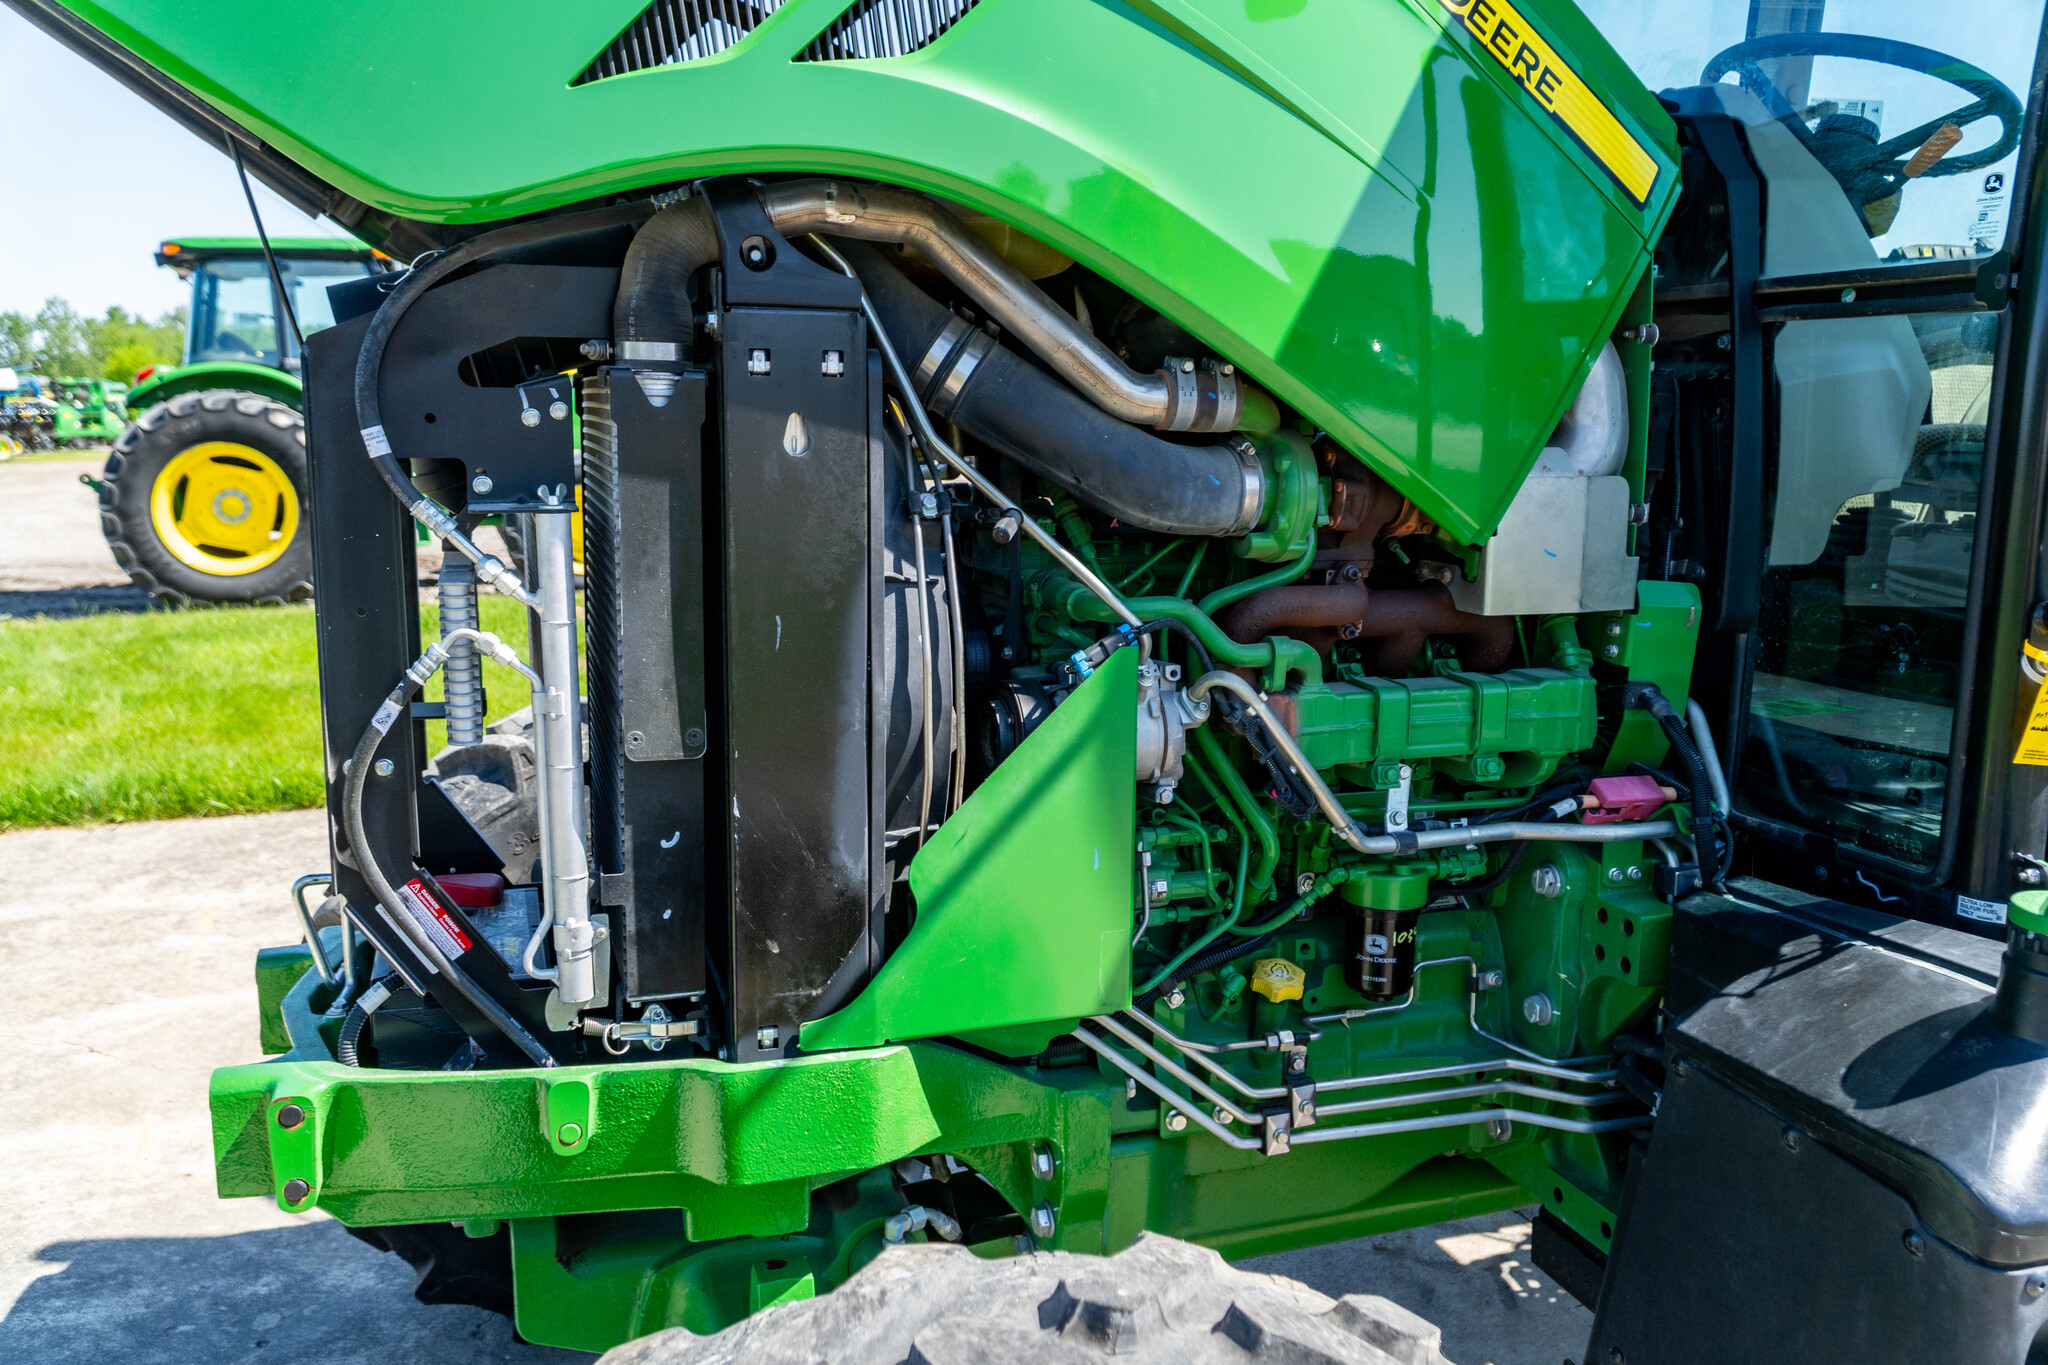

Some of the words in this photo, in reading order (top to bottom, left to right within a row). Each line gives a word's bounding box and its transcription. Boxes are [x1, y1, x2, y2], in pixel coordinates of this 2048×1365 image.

[1447, 0, 1563, 106] EERE
[1960, 897, 1978, 905] ULTRA
[420, 889, 440, 910] DANGER!
[442, 914, 460, 934] POISON!
[1960, 903, 1981, 912] SULFUR
[1356, 953, 1373, 962] JOHN
